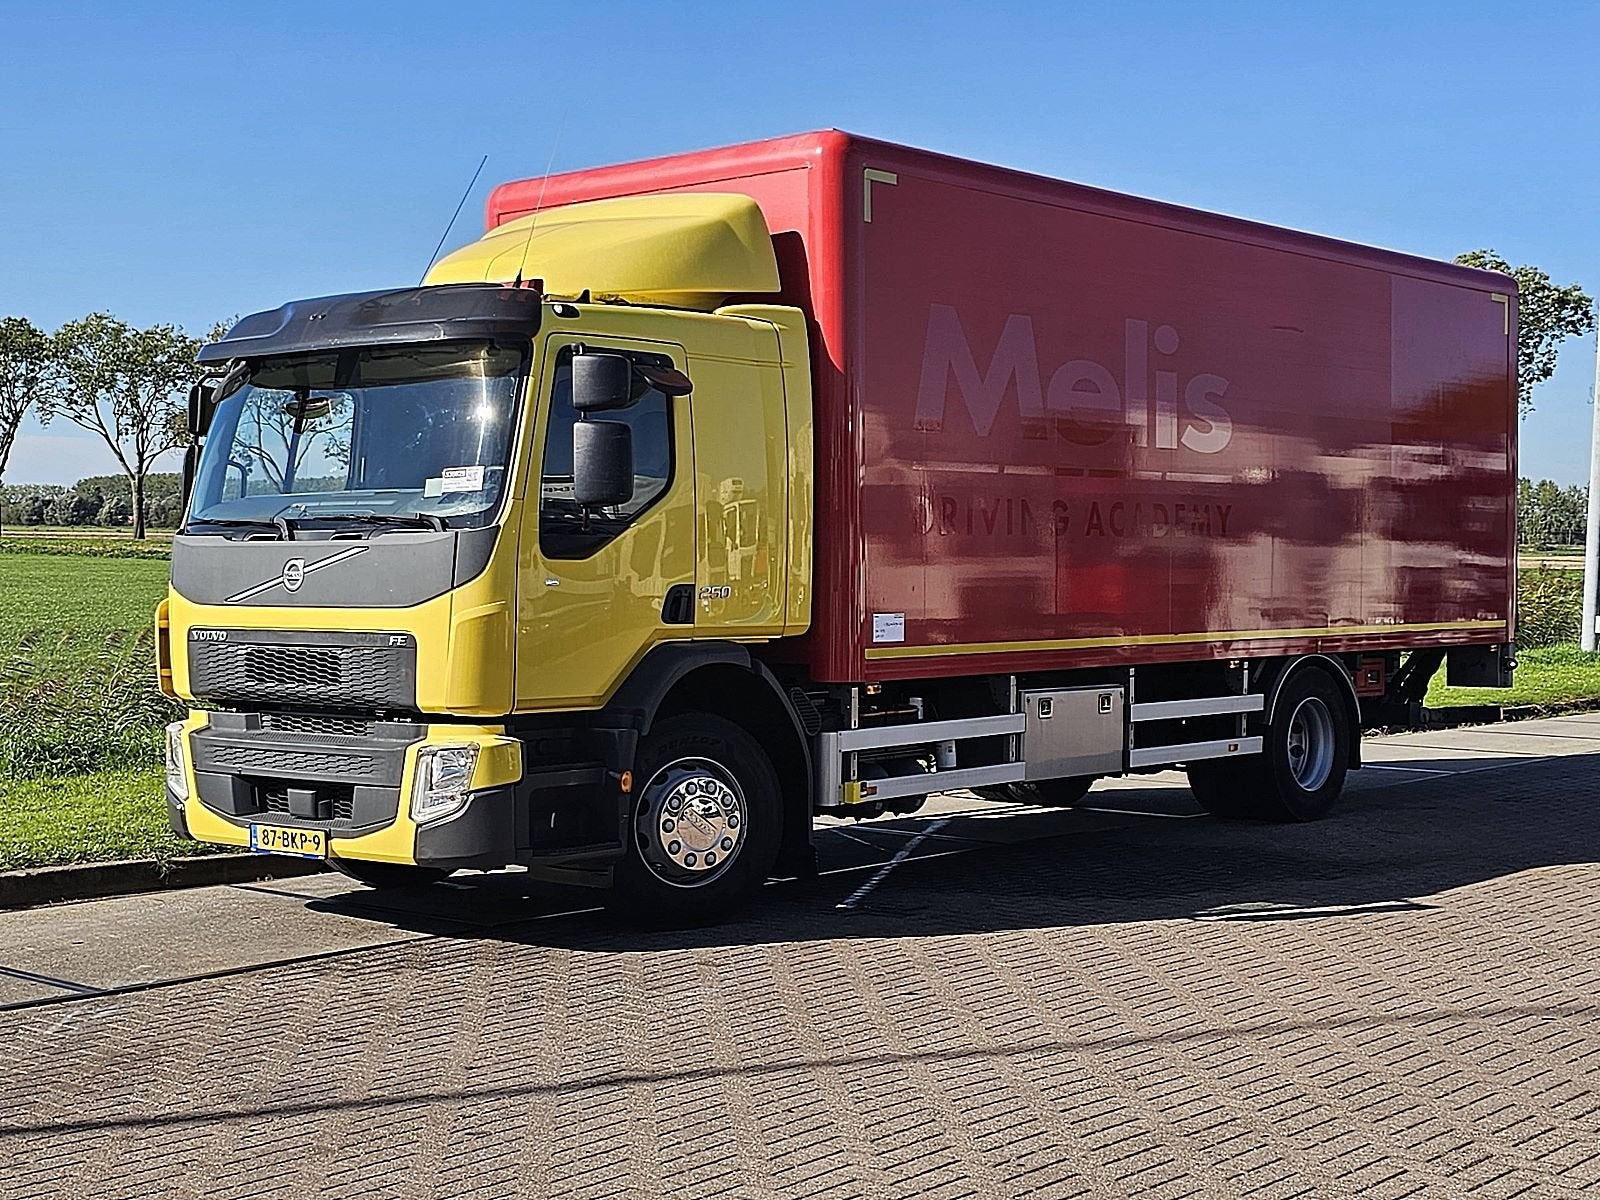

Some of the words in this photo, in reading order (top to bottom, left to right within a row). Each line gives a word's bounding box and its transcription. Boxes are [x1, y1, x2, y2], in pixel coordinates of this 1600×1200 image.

[912, 303, 1233, 454] Melis
[916, 496, 1070, 537] DRIVING
[1084, 500, 1234, 538] ACADEMY
[699, 585, 732, 600] 250
[191, 629, 228, 642] VOLVO
[388, 635, 408, 646] FE
[262, 828, 321, 851] 87-BKP-9
